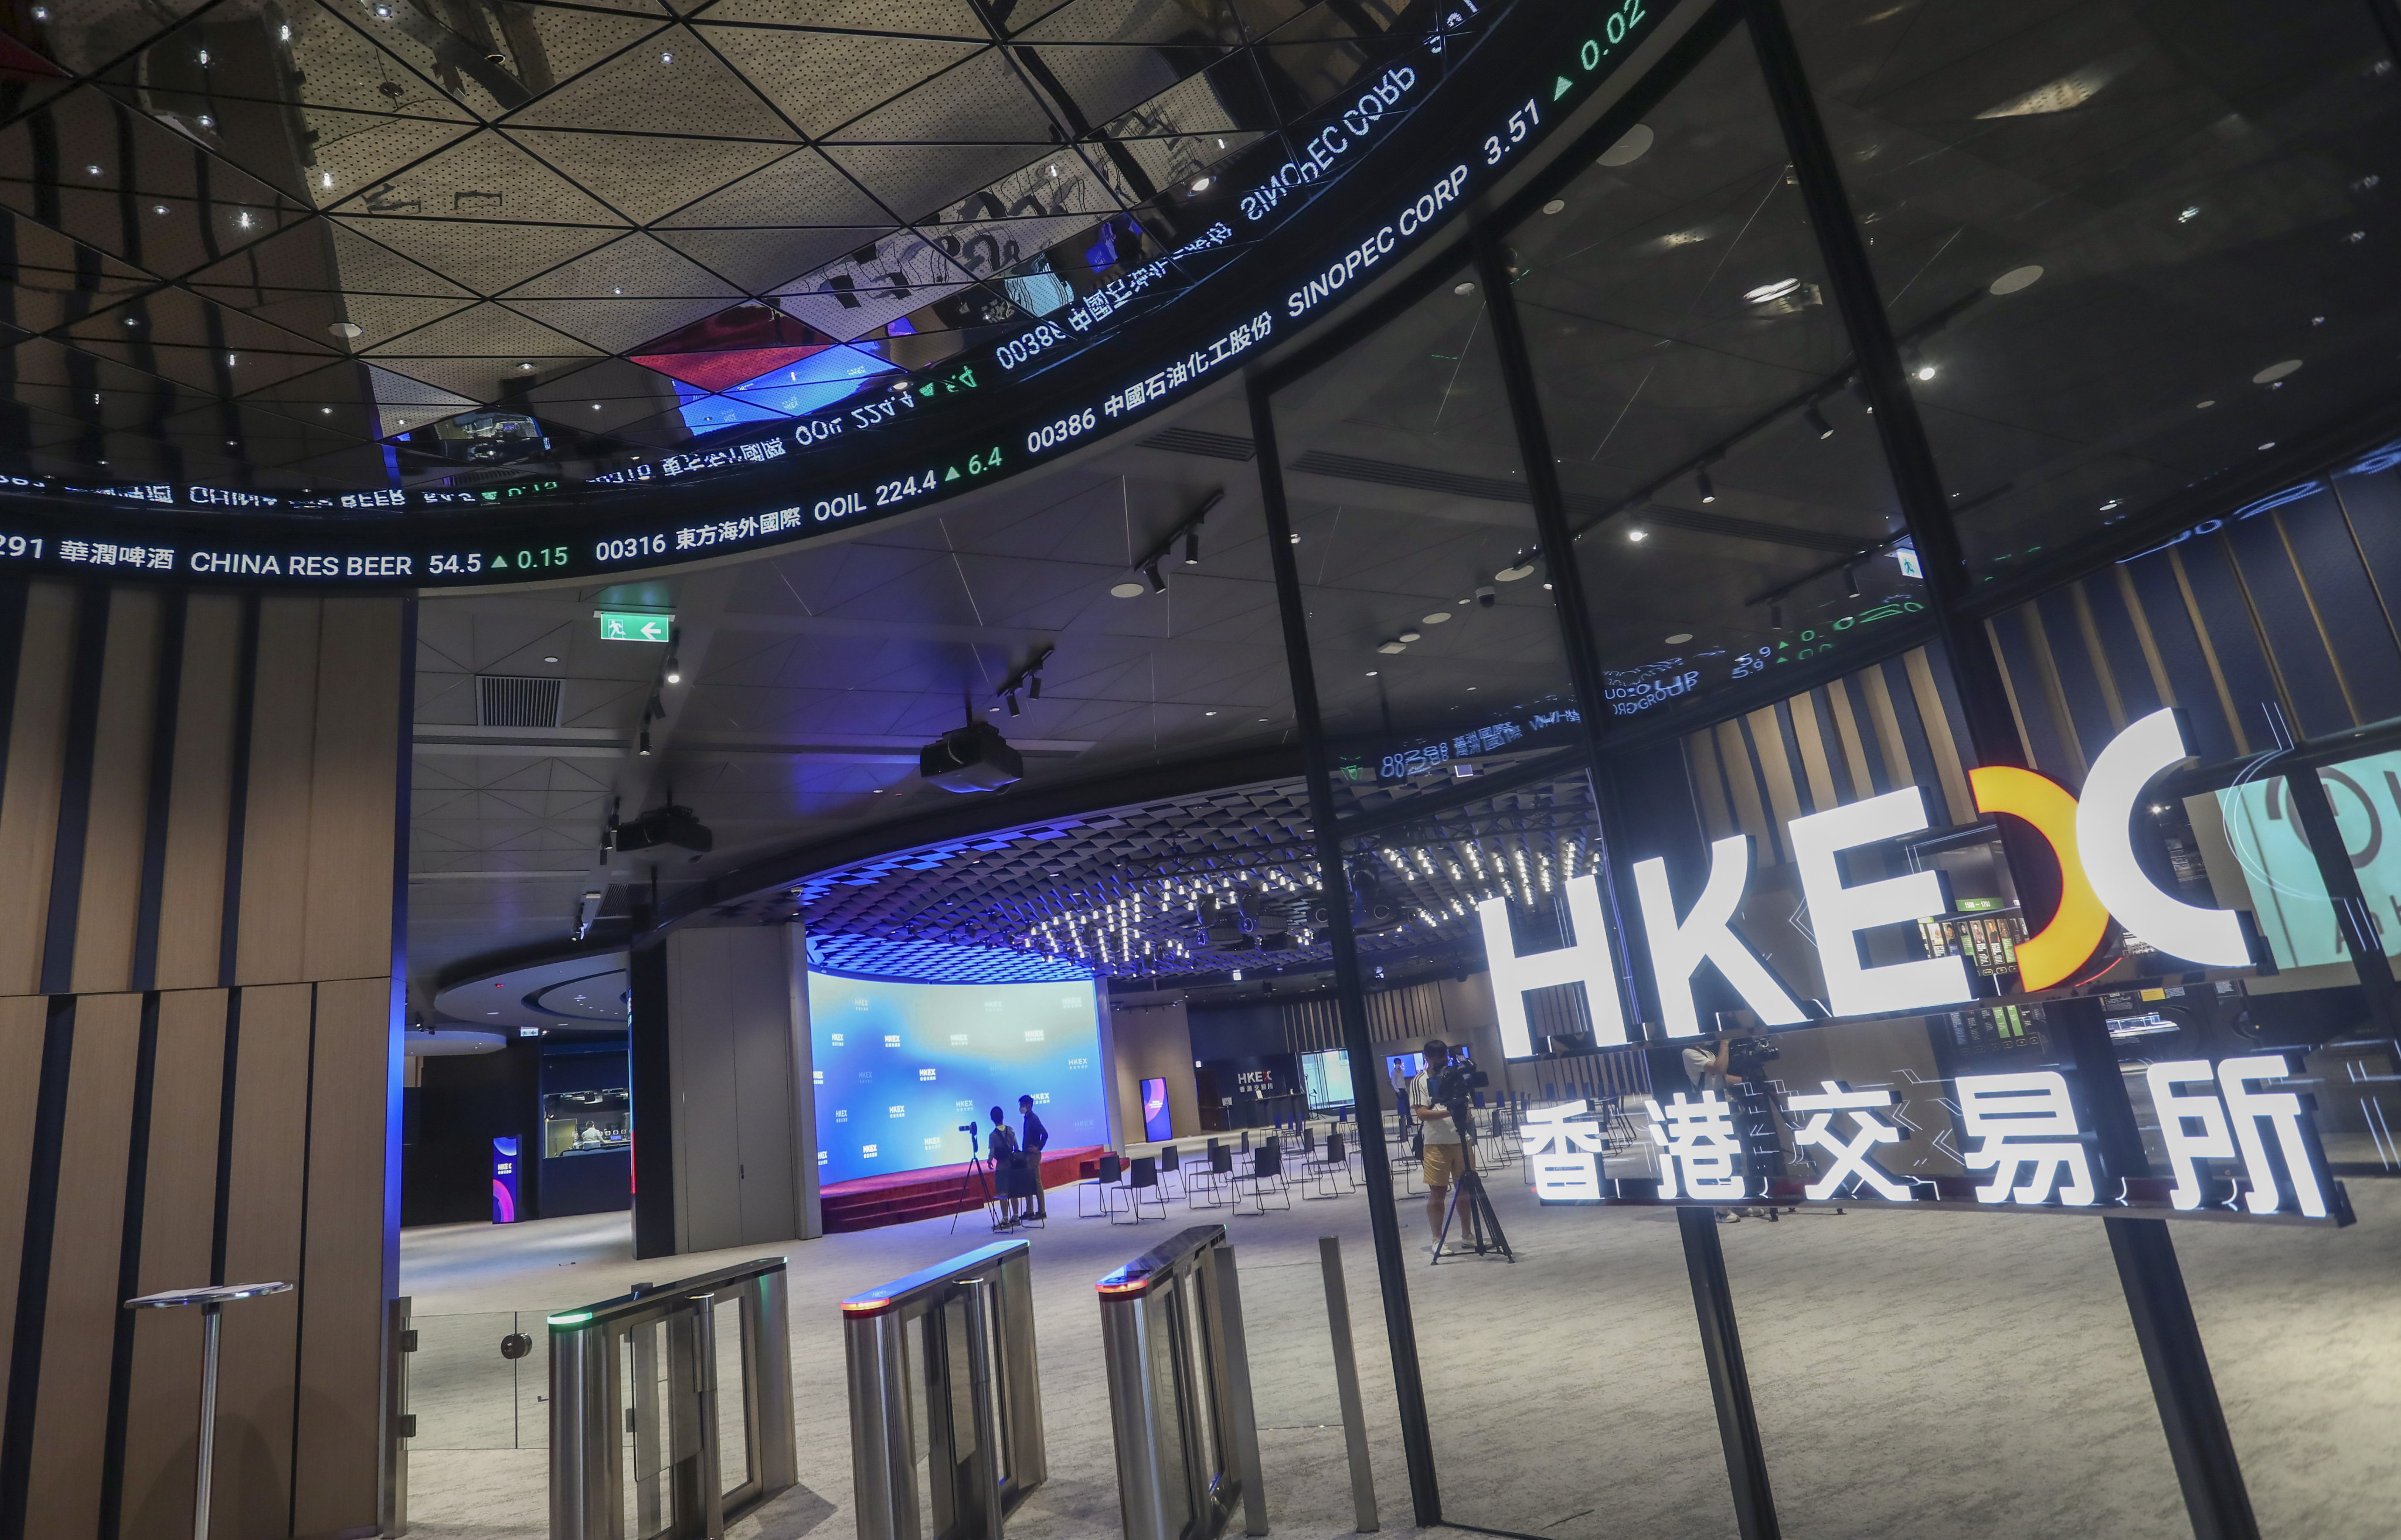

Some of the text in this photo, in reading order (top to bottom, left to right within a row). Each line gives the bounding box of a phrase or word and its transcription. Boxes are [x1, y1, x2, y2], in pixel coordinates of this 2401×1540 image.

[1484, 0, 1645, 165] 3.51 0.02
[1027, 164, 1469, 454] 00386 中國石油化工股份 SINOPEC CORP
[59, 540, 175, 570] 華潤啤酒
[191, 551, 281, 575] CHINA
[288, 556, 340, 576] RES
[346, 556, 412, 576] BEER
[428, 553, 481, 574] 54.5
[517, 546, 568, 570] 0.15
[596, 447, 1002, 561] 00316 東方海外國際 OOIL 224.4 6.4
[1477, 708, 2255, 1059] HKEX
[889, 1105, 904, 1113] HKEX
[1237, 1070, 1273, 1084] HKEX
[1521, 1055, 2329, 1219] 香港交易所
